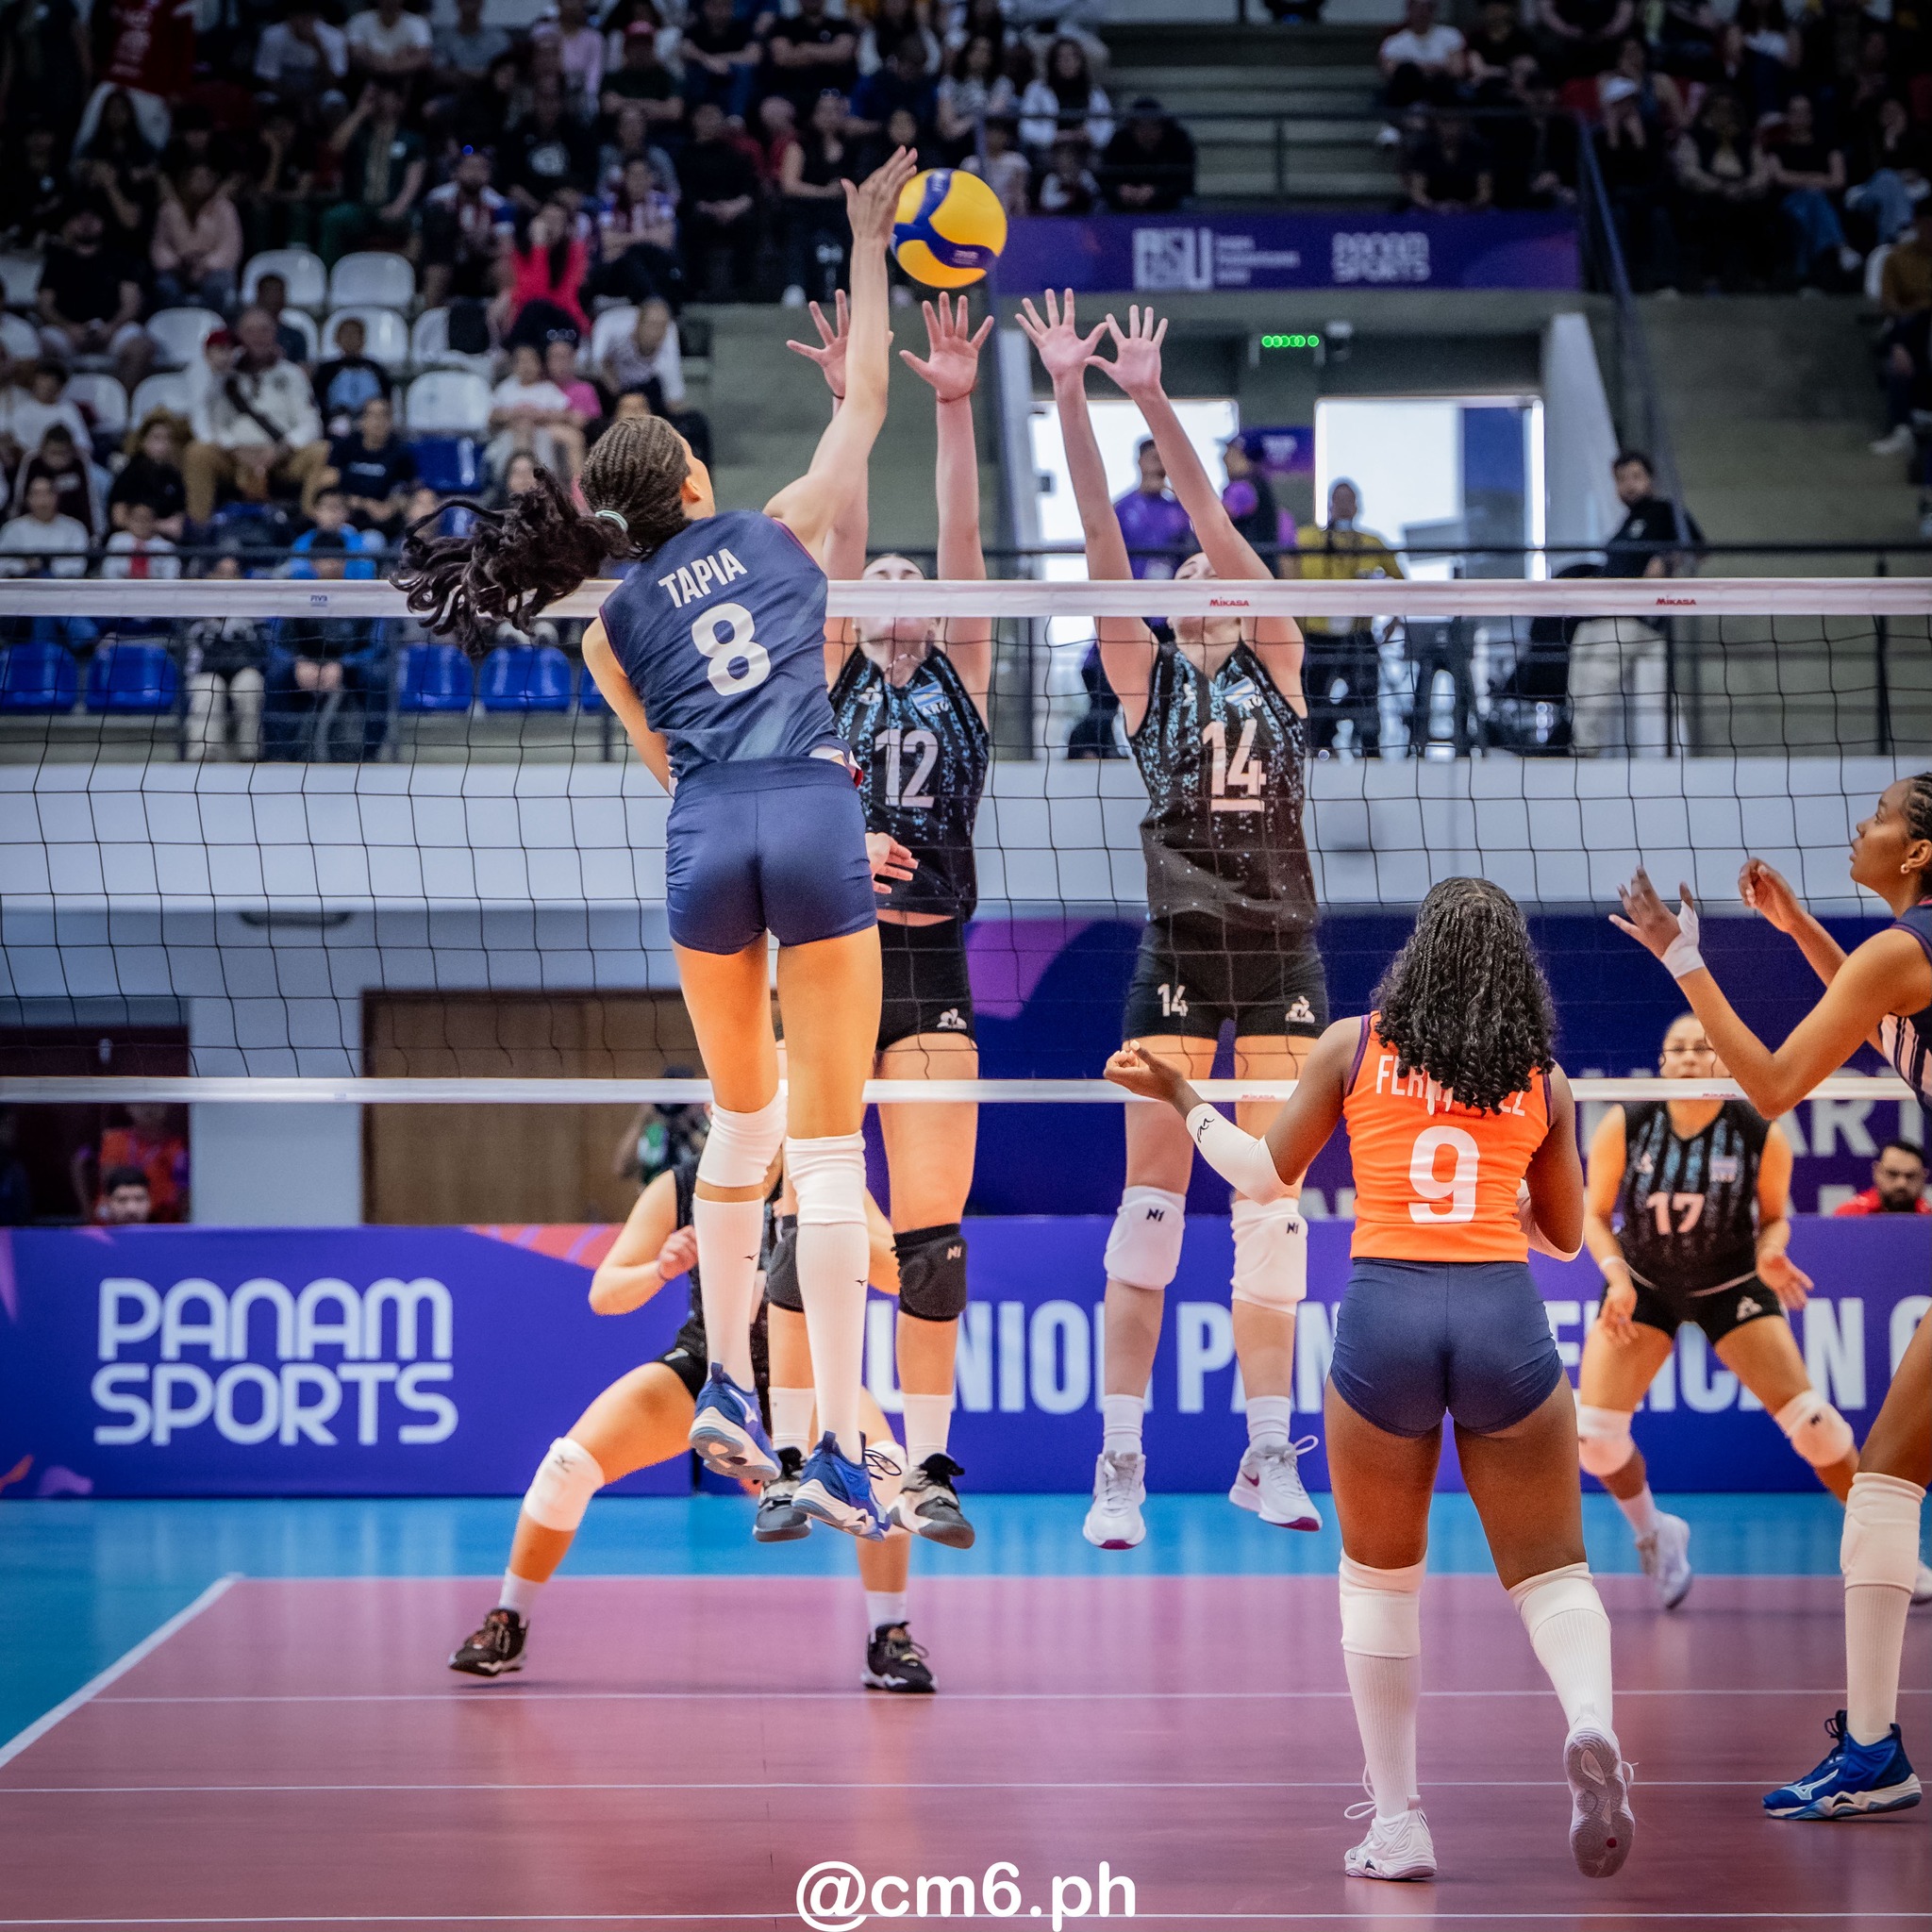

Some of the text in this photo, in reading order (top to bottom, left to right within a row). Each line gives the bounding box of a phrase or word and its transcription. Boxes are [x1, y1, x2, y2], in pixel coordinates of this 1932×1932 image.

[658, 548, 747, 608] TAPIA
[691, 602, 772, 696] 8
[874, 728, 939, 808] 12
[1202, 718, 1267, 796] 14
[1158, 983, 1189, 1017] 14
[1407, 1124, 1480, 1224] 9
[1646, 1191, 1705, 1236] 17
[97, 1276, 455, 1362] PANAM
[91, 1361, 460, 1447] SPORTS
